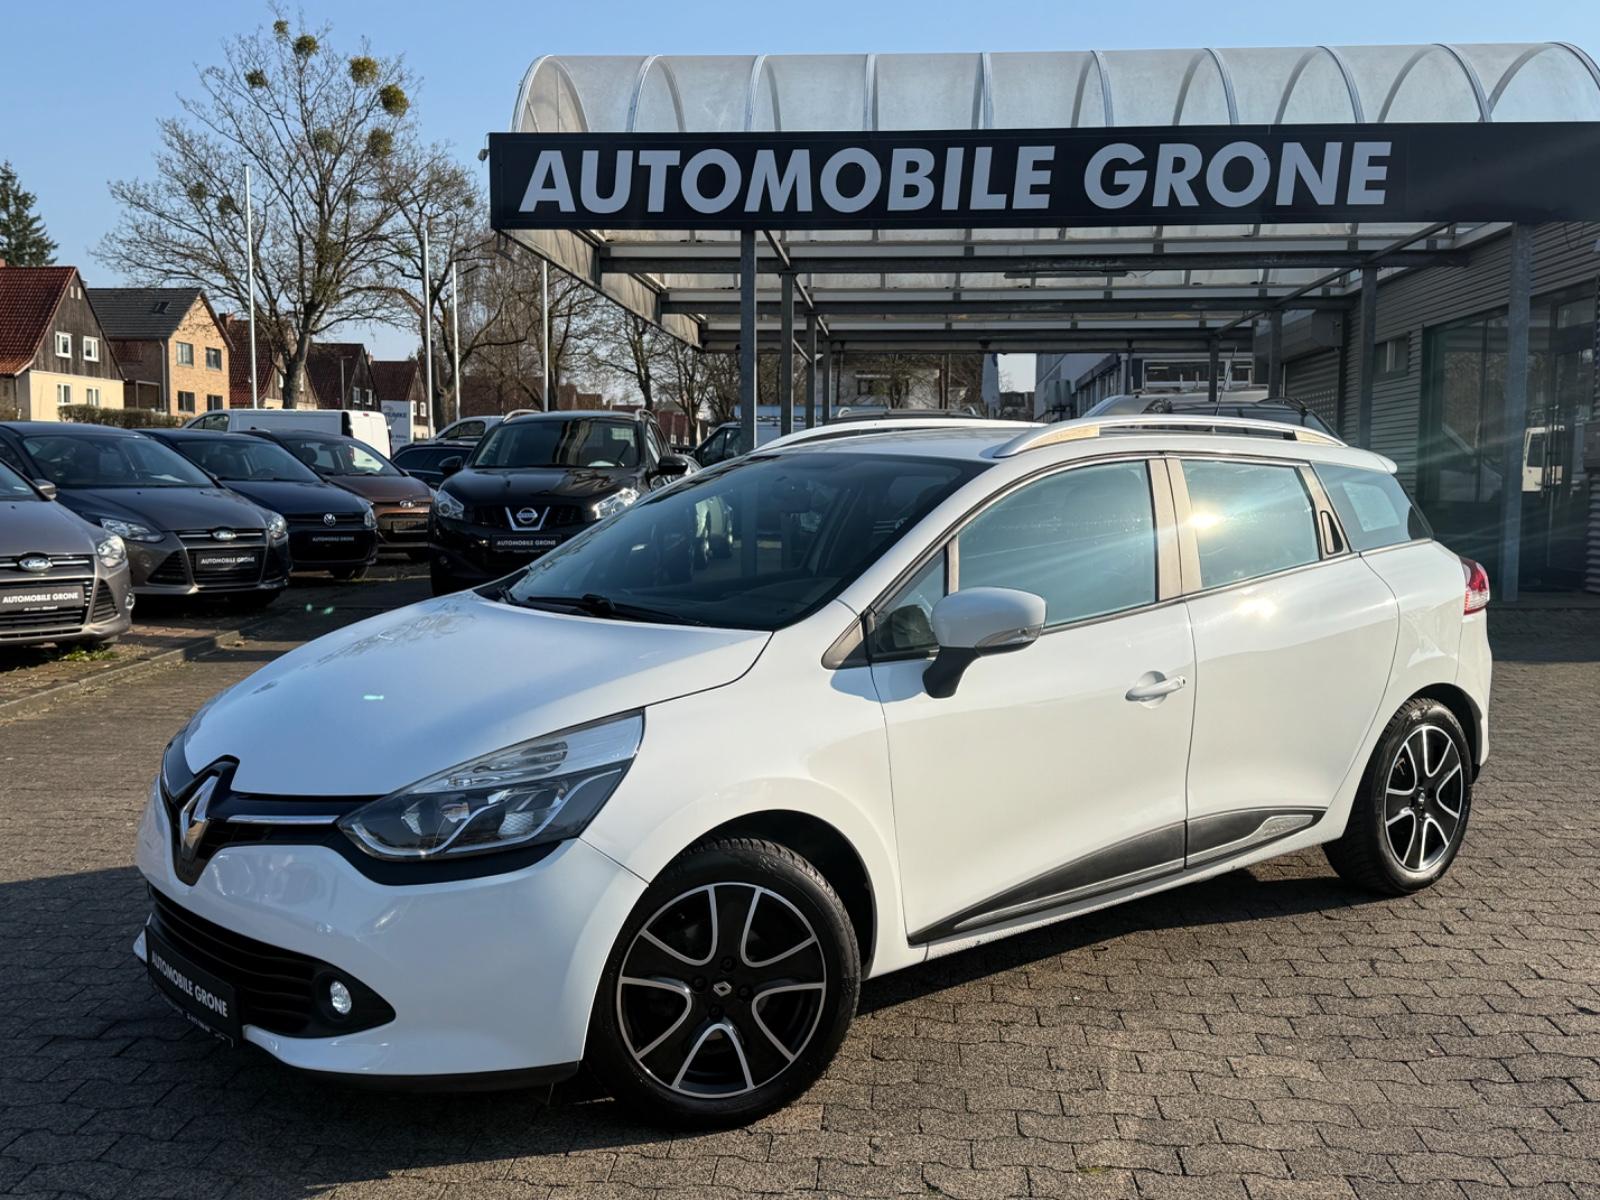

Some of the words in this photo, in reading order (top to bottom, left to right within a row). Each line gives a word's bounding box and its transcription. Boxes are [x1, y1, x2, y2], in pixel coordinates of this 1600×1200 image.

[519, 147, 1053, 215] AUTOMOBILE
[1084, 141, 1392, 210] GRONE
[201, 557, 236, 565] AUTOMOBILE
[2, 594, 51, 604] AUTOMOBILE
[52, 592, 79, 601] GRONE
[152, 951, 194, 996] AUTOMOBILE
[195, 985, 228, 1017] GRONE
